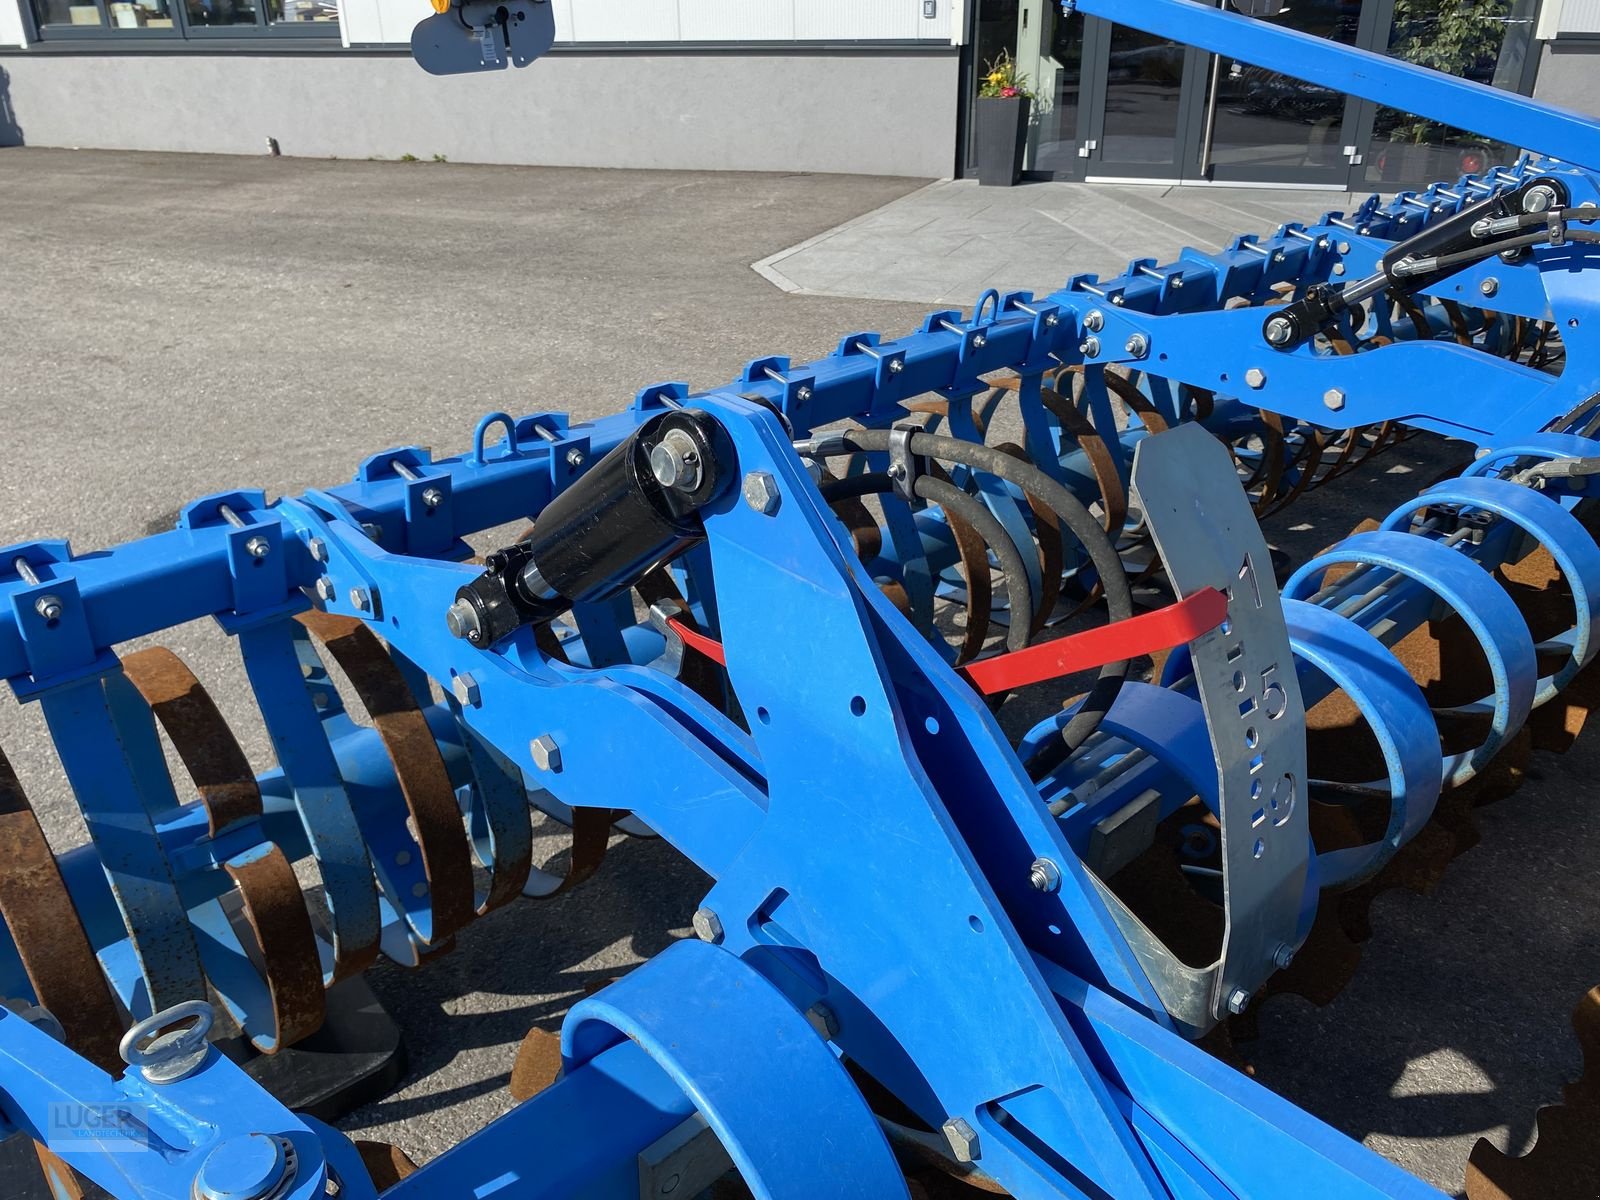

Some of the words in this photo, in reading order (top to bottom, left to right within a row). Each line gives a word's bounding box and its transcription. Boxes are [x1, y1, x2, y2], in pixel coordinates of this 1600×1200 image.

[1238, 551, 1263, 609] 1
[1260, 662, 1288, 721] 5
[1270, 772, 1297, 828] 9
